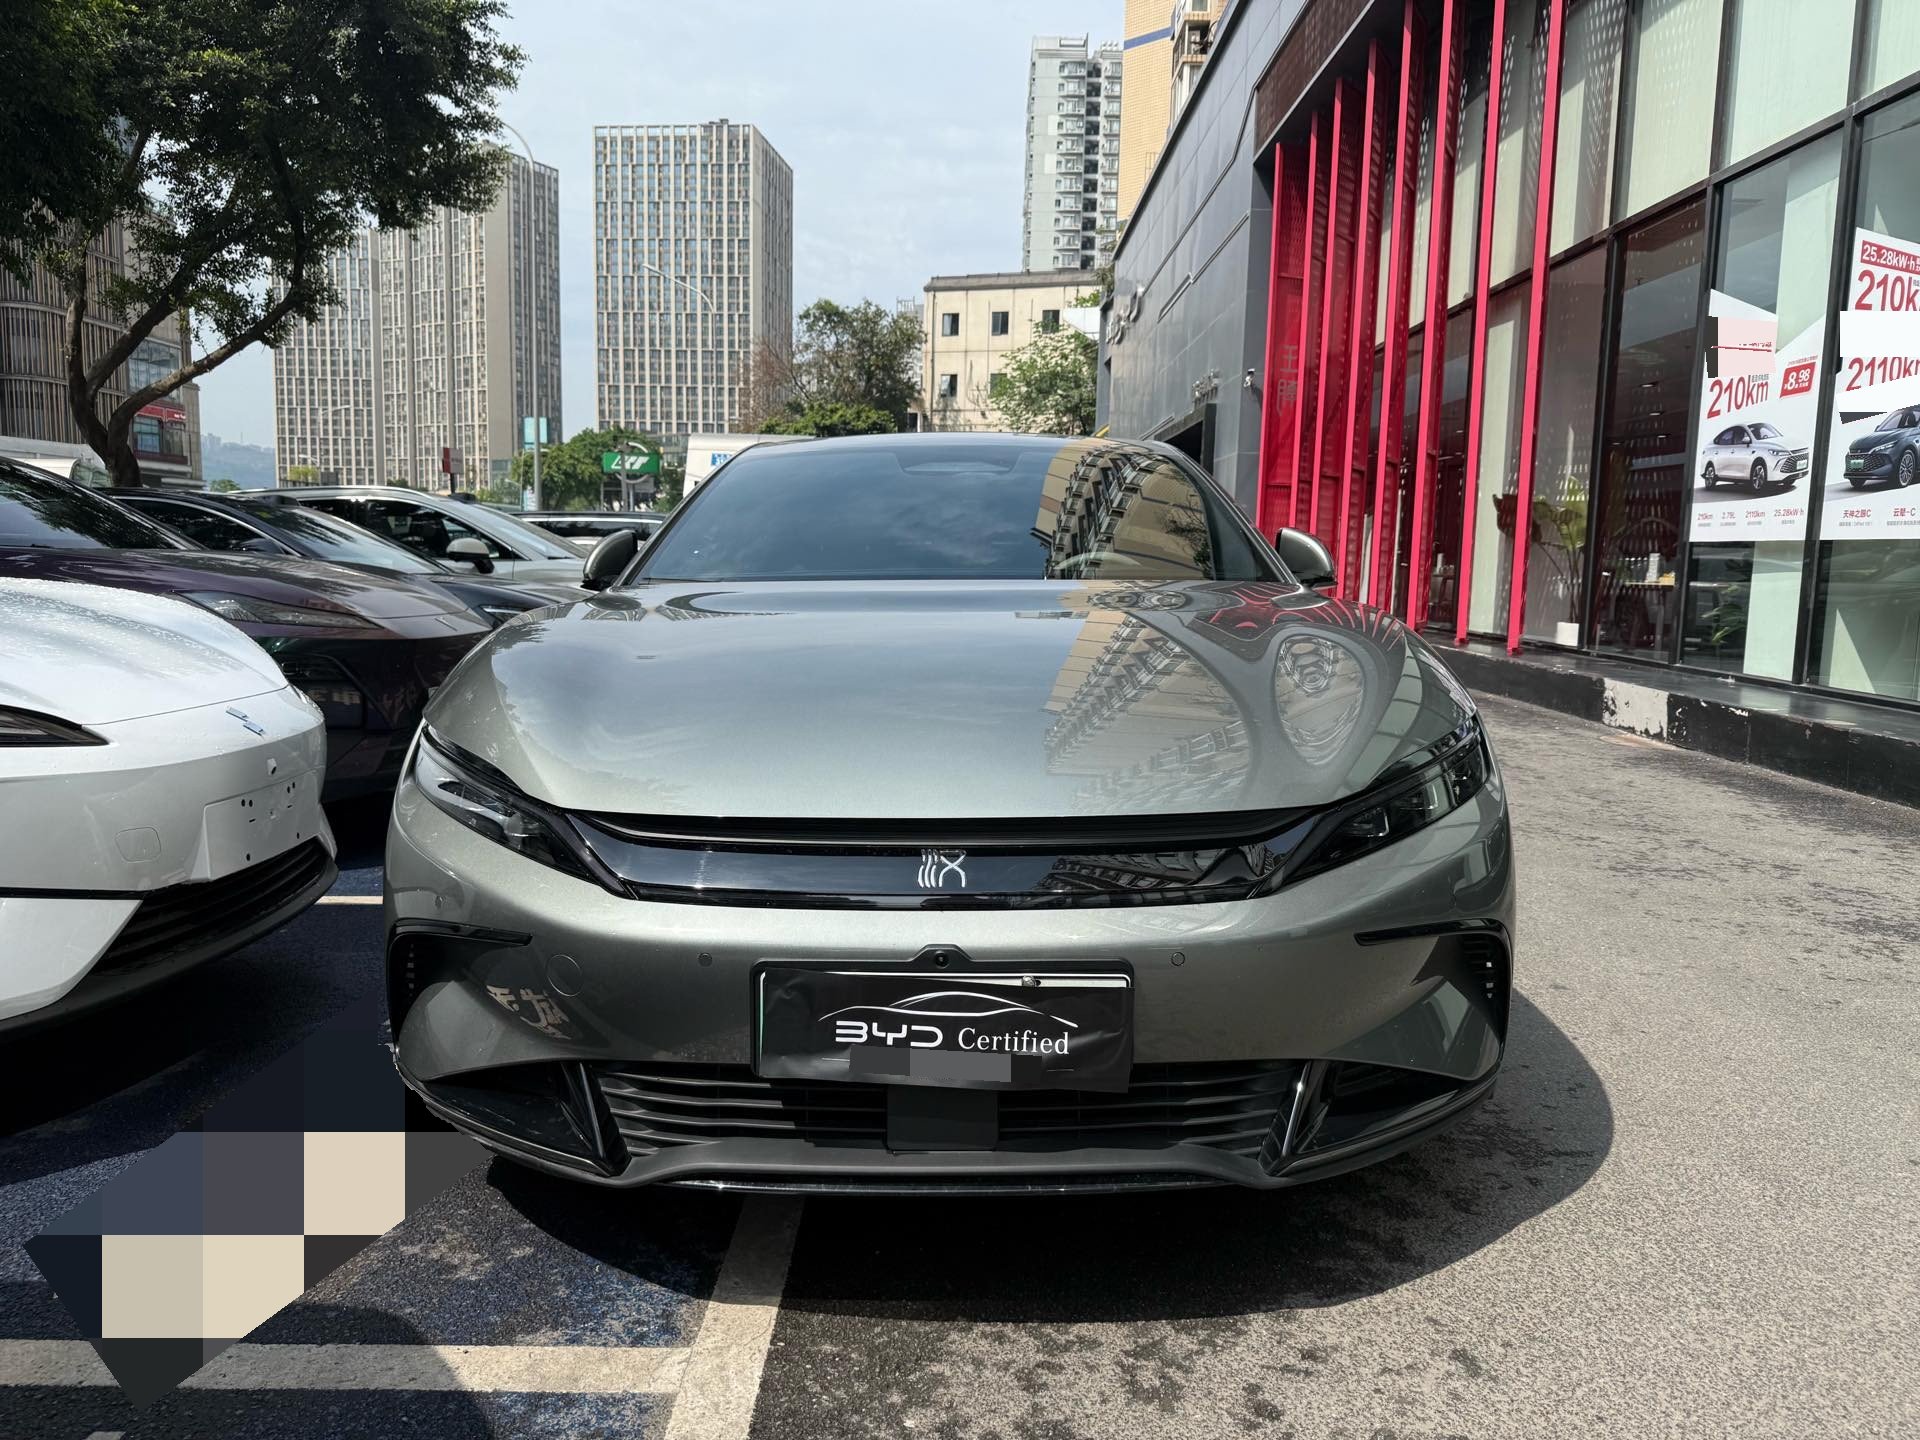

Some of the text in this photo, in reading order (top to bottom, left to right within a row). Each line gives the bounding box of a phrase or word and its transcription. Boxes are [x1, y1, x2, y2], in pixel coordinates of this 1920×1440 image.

[1855, 269, 1920, 311] 210k
[1707, 374, 1769, 418] 210km
[834, 1020, 1070, 1055] BYD Certified
